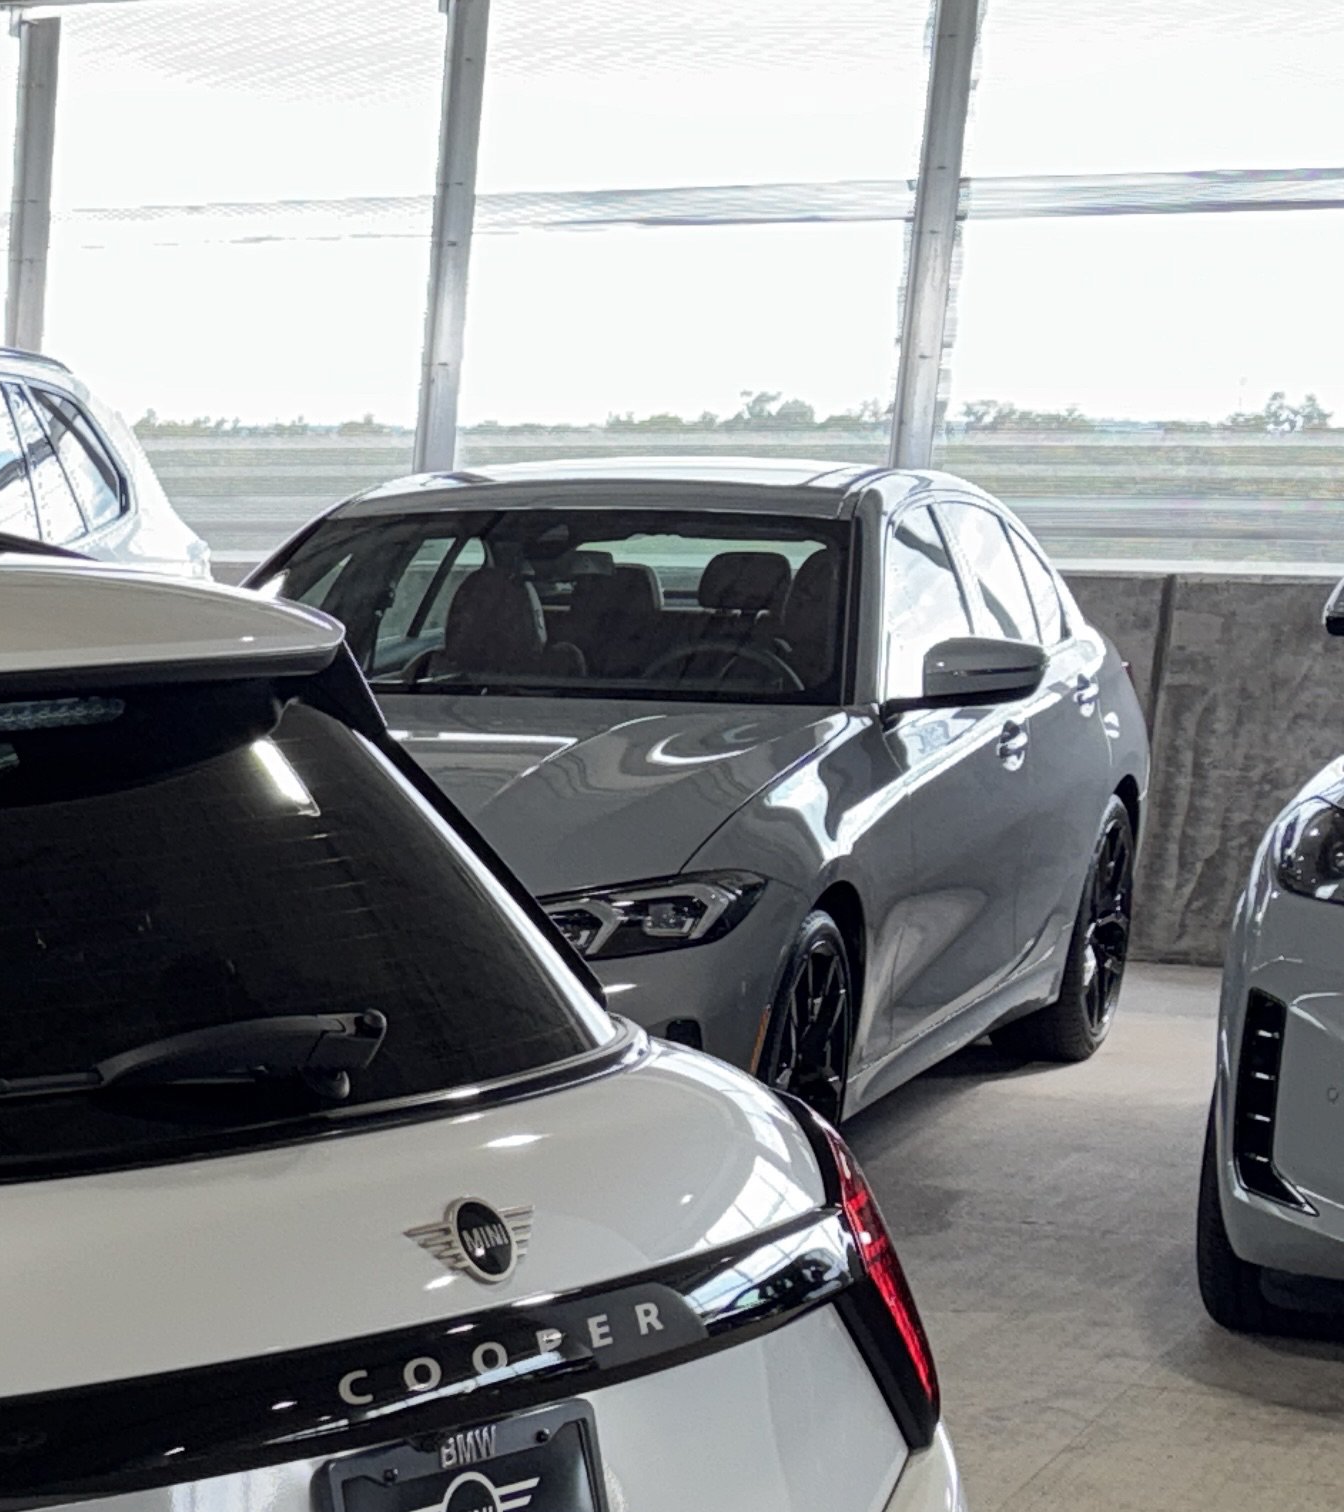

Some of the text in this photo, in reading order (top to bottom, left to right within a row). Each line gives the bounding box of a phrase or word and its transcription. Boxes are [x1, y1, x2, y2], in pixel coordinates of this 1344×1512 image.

[462, 1223, 509, 1254] MINI
[337, 1302, 664, 1405] COOPER
[440, 1424, 497, 1469] BMW
